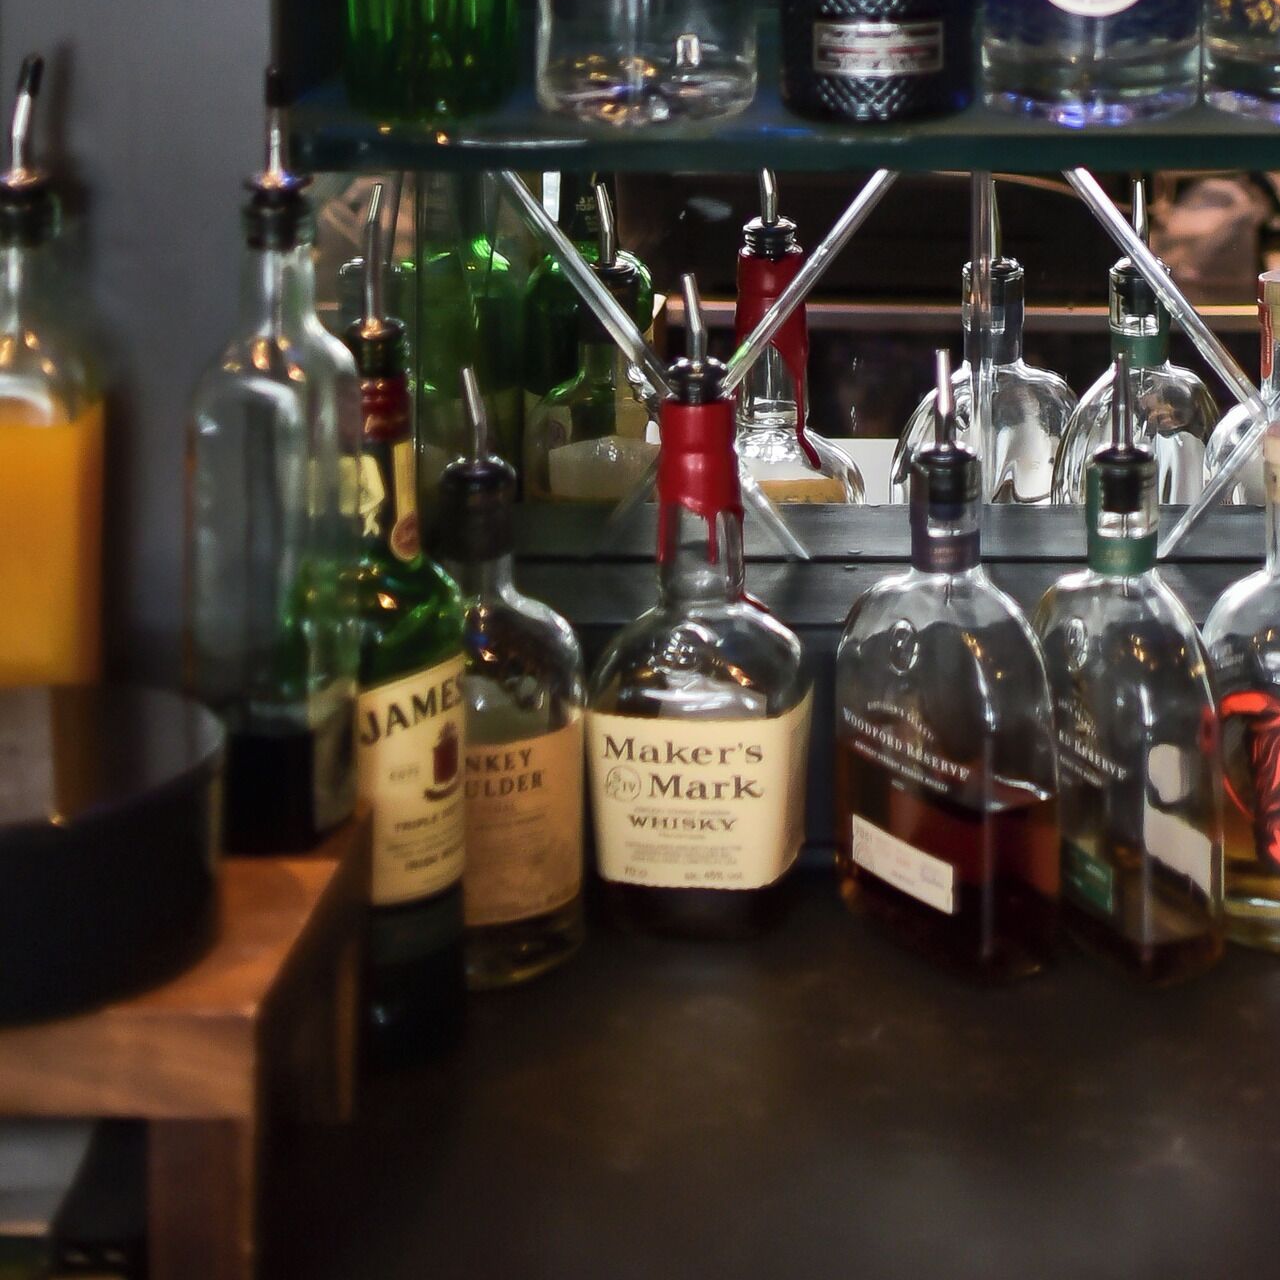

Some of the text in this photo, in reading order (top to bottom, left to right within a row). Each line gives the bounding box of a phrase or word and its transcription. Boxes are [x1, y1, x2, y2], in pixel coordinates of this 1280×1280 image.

[360, 671, 464, 745] JAMES
[602, 733, 764, 765] Maker's
[843, 706, 970, 781] WOODFORD RESERVE
[465, 748, 533, 773] NKEY
[465, 769, 545, 800] ULDER
[648, 772, 766, 801] Mark
[627, 814, 738, 832] WHISKY
